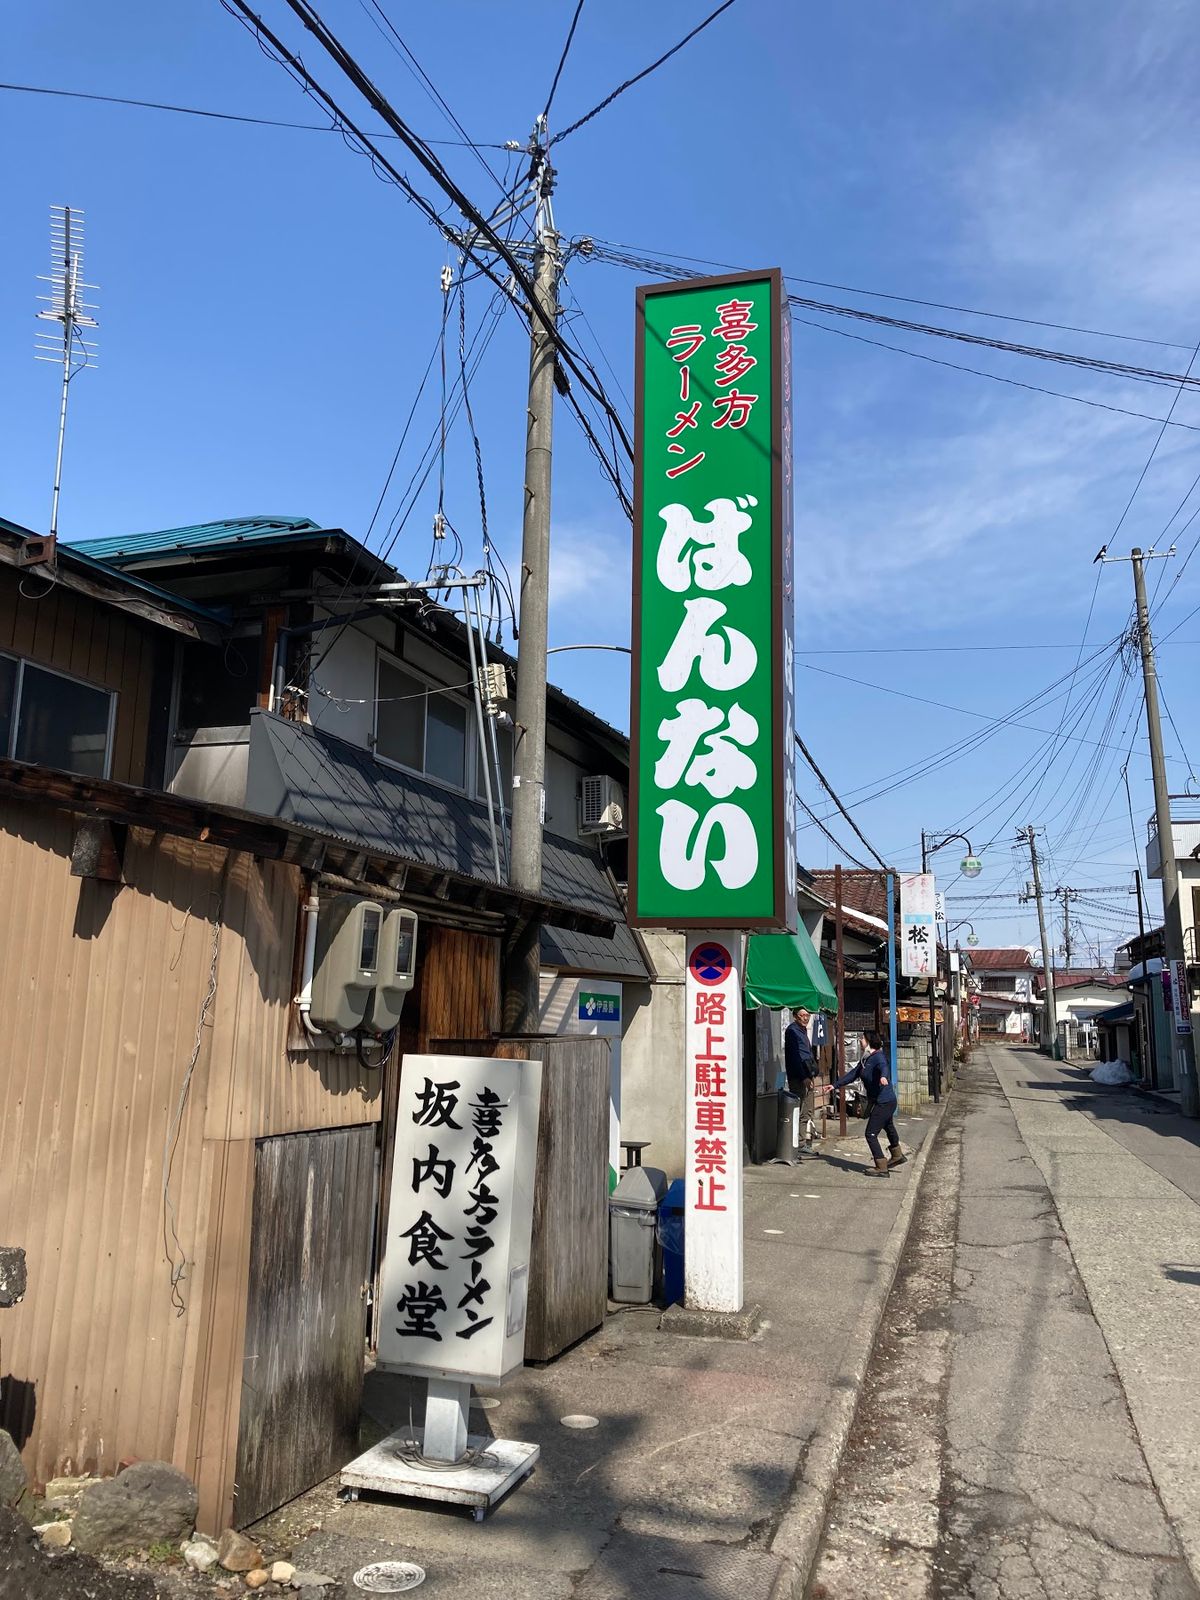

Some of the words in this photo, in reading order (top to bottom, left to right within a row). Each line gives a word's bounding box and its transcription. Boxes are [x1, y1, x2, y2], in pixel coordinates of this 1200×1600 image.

[666, 324, 706, 478] ラーメン
[711, 299, 758, 428] 喜多方
[654, 494, 759, 890] ばんない
[908, 925, 929, 944] 松
[396, 1077, 463, 1342] 坂内食堂
[694, 992, 727, 1211] 路上駐車禁止
[456, 1086, 508, 1340] 喜多方ラーメン
